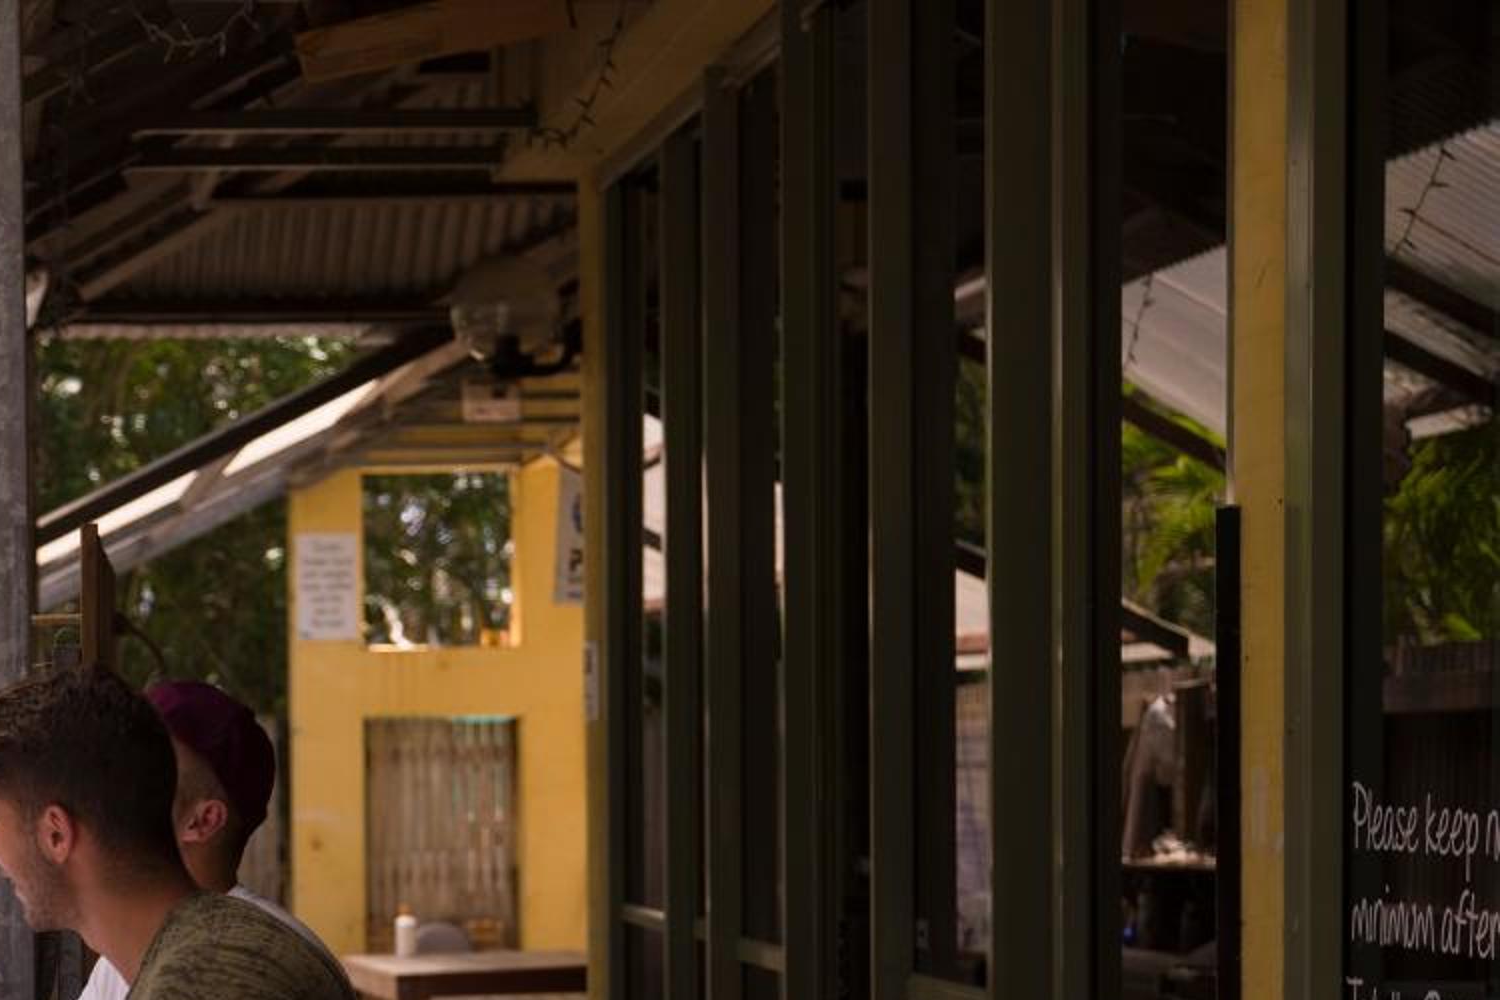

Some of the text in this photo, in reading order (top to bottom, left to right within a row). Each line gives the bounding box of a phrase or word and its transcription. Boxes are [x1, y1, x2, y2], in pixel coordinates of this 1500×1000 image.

[1351, 780, 1419, 853] Please
[1425, 793, 1479, 882] keep
[1350, 884, 1436, 952] minimum
